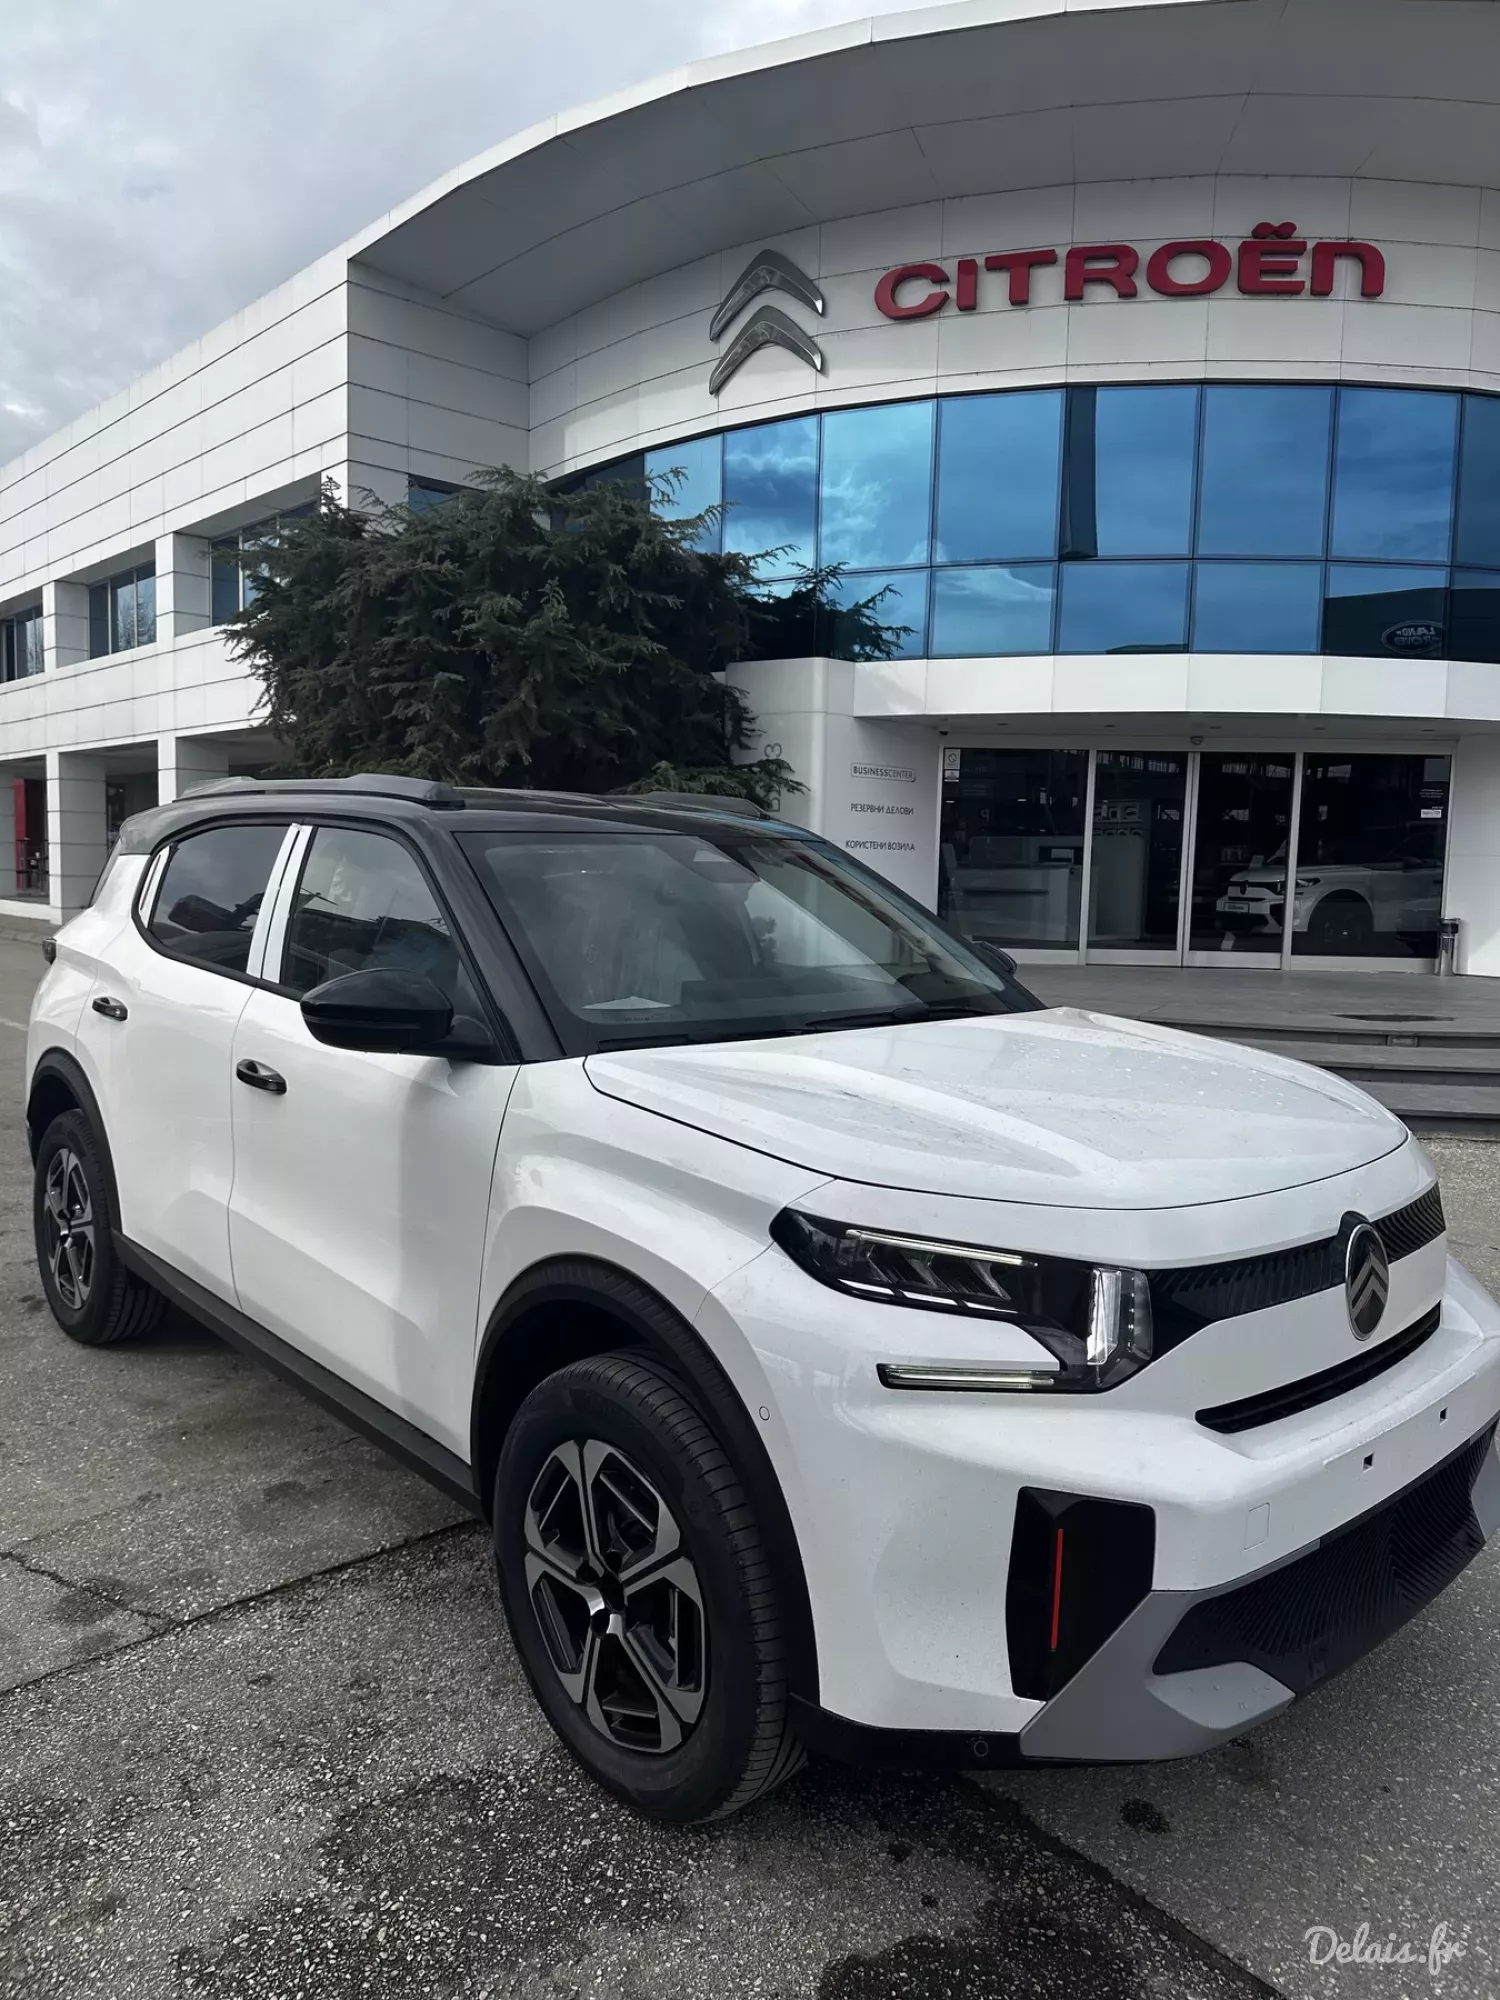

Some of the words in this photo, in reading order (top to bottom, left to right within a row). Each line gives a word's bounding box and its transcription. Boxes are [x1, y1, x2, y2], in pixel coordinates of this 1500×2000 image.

[874, 221, 1386, 321] CITROËN
[850, 802, 884, 813] РЕЗЕРВНИ
[885, 805, 914, 815] ДЕЛОВИ
[845, 839, 887, 850] КОРИСТЕНИ
[887, 841, 915, 851] ВОЗИЛА
